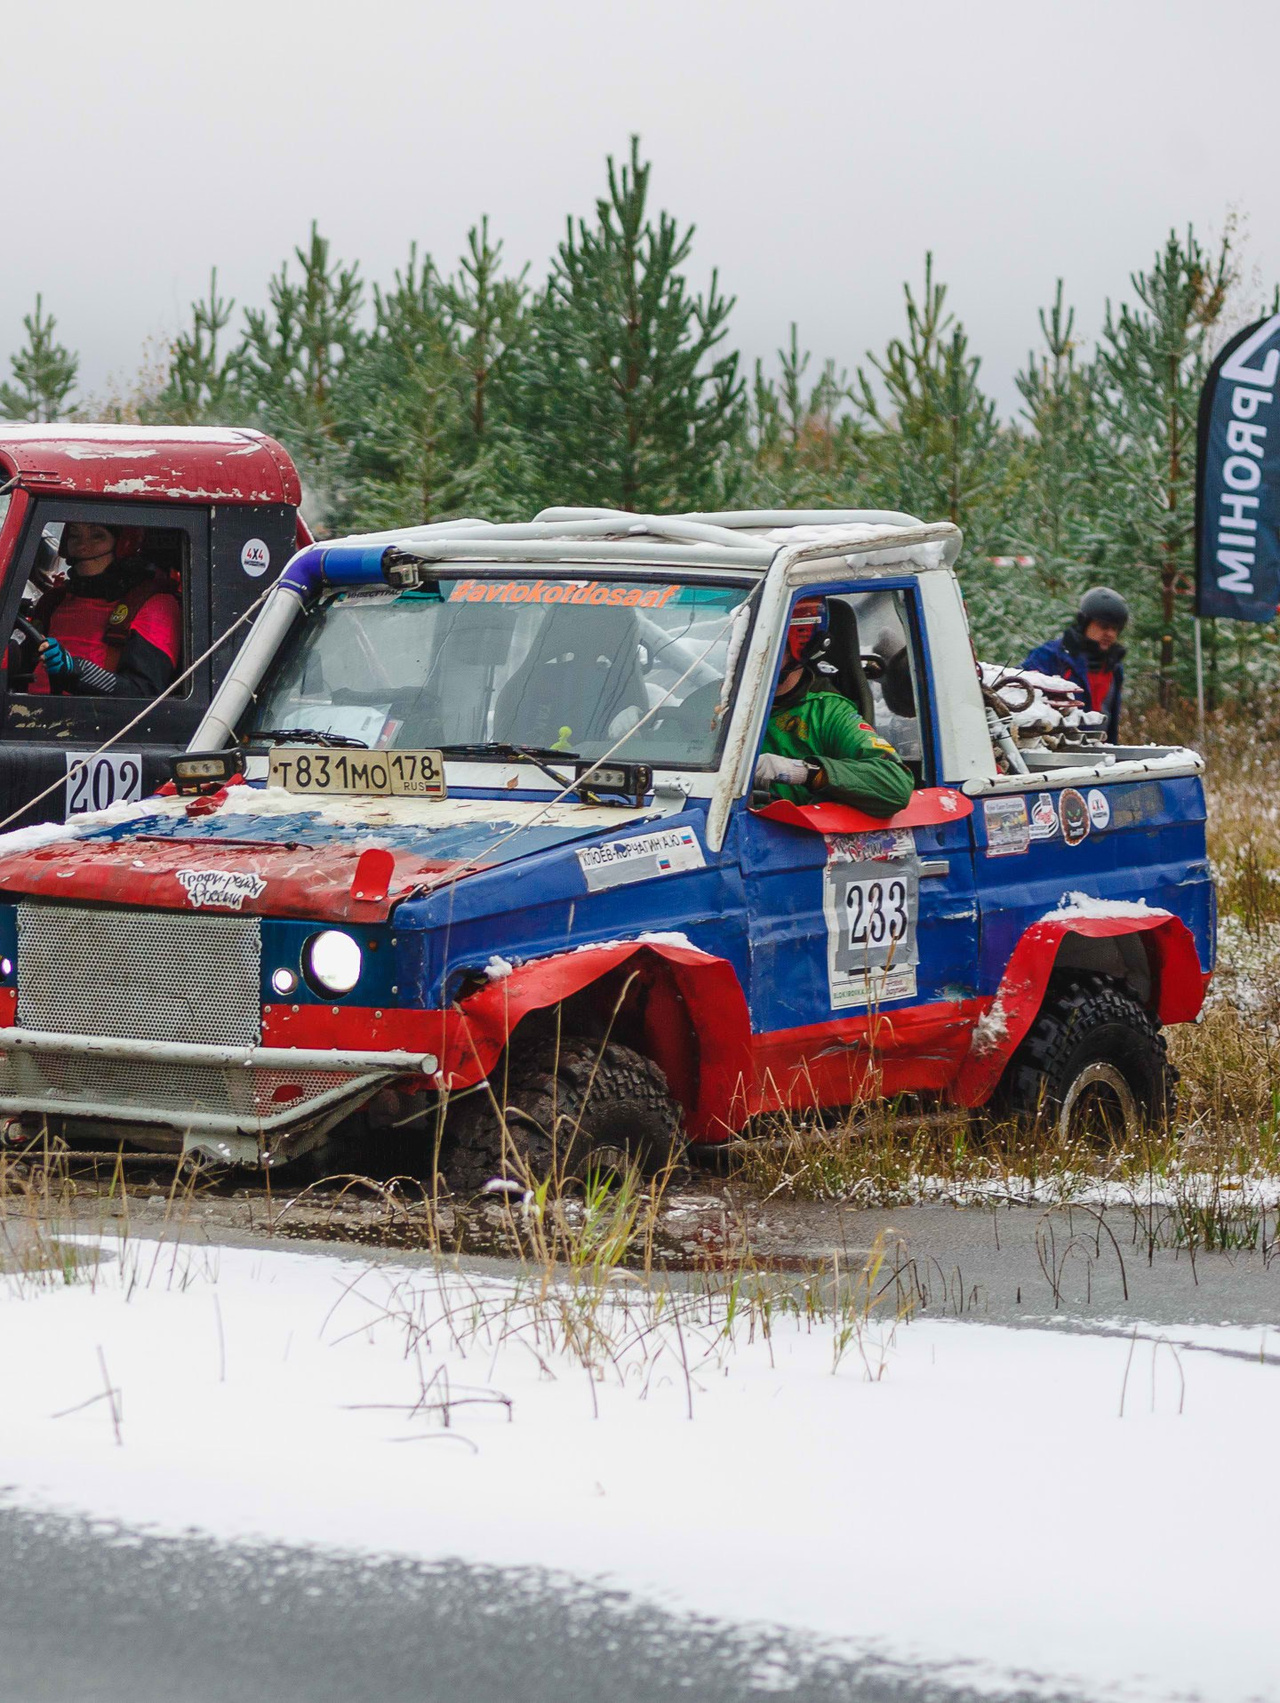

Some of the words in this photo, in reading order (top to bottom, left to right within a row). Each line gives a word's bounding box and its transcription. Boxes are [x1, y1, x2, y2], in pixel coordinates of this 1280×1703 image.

[450, 579, 681, 608] #avtokotdosaaf
[392, 755, 434, 780] 178
[70, 759, 139, 813] 202
[404, 781, 425, 791] RUS
[847, 881, 907, 944] 233
